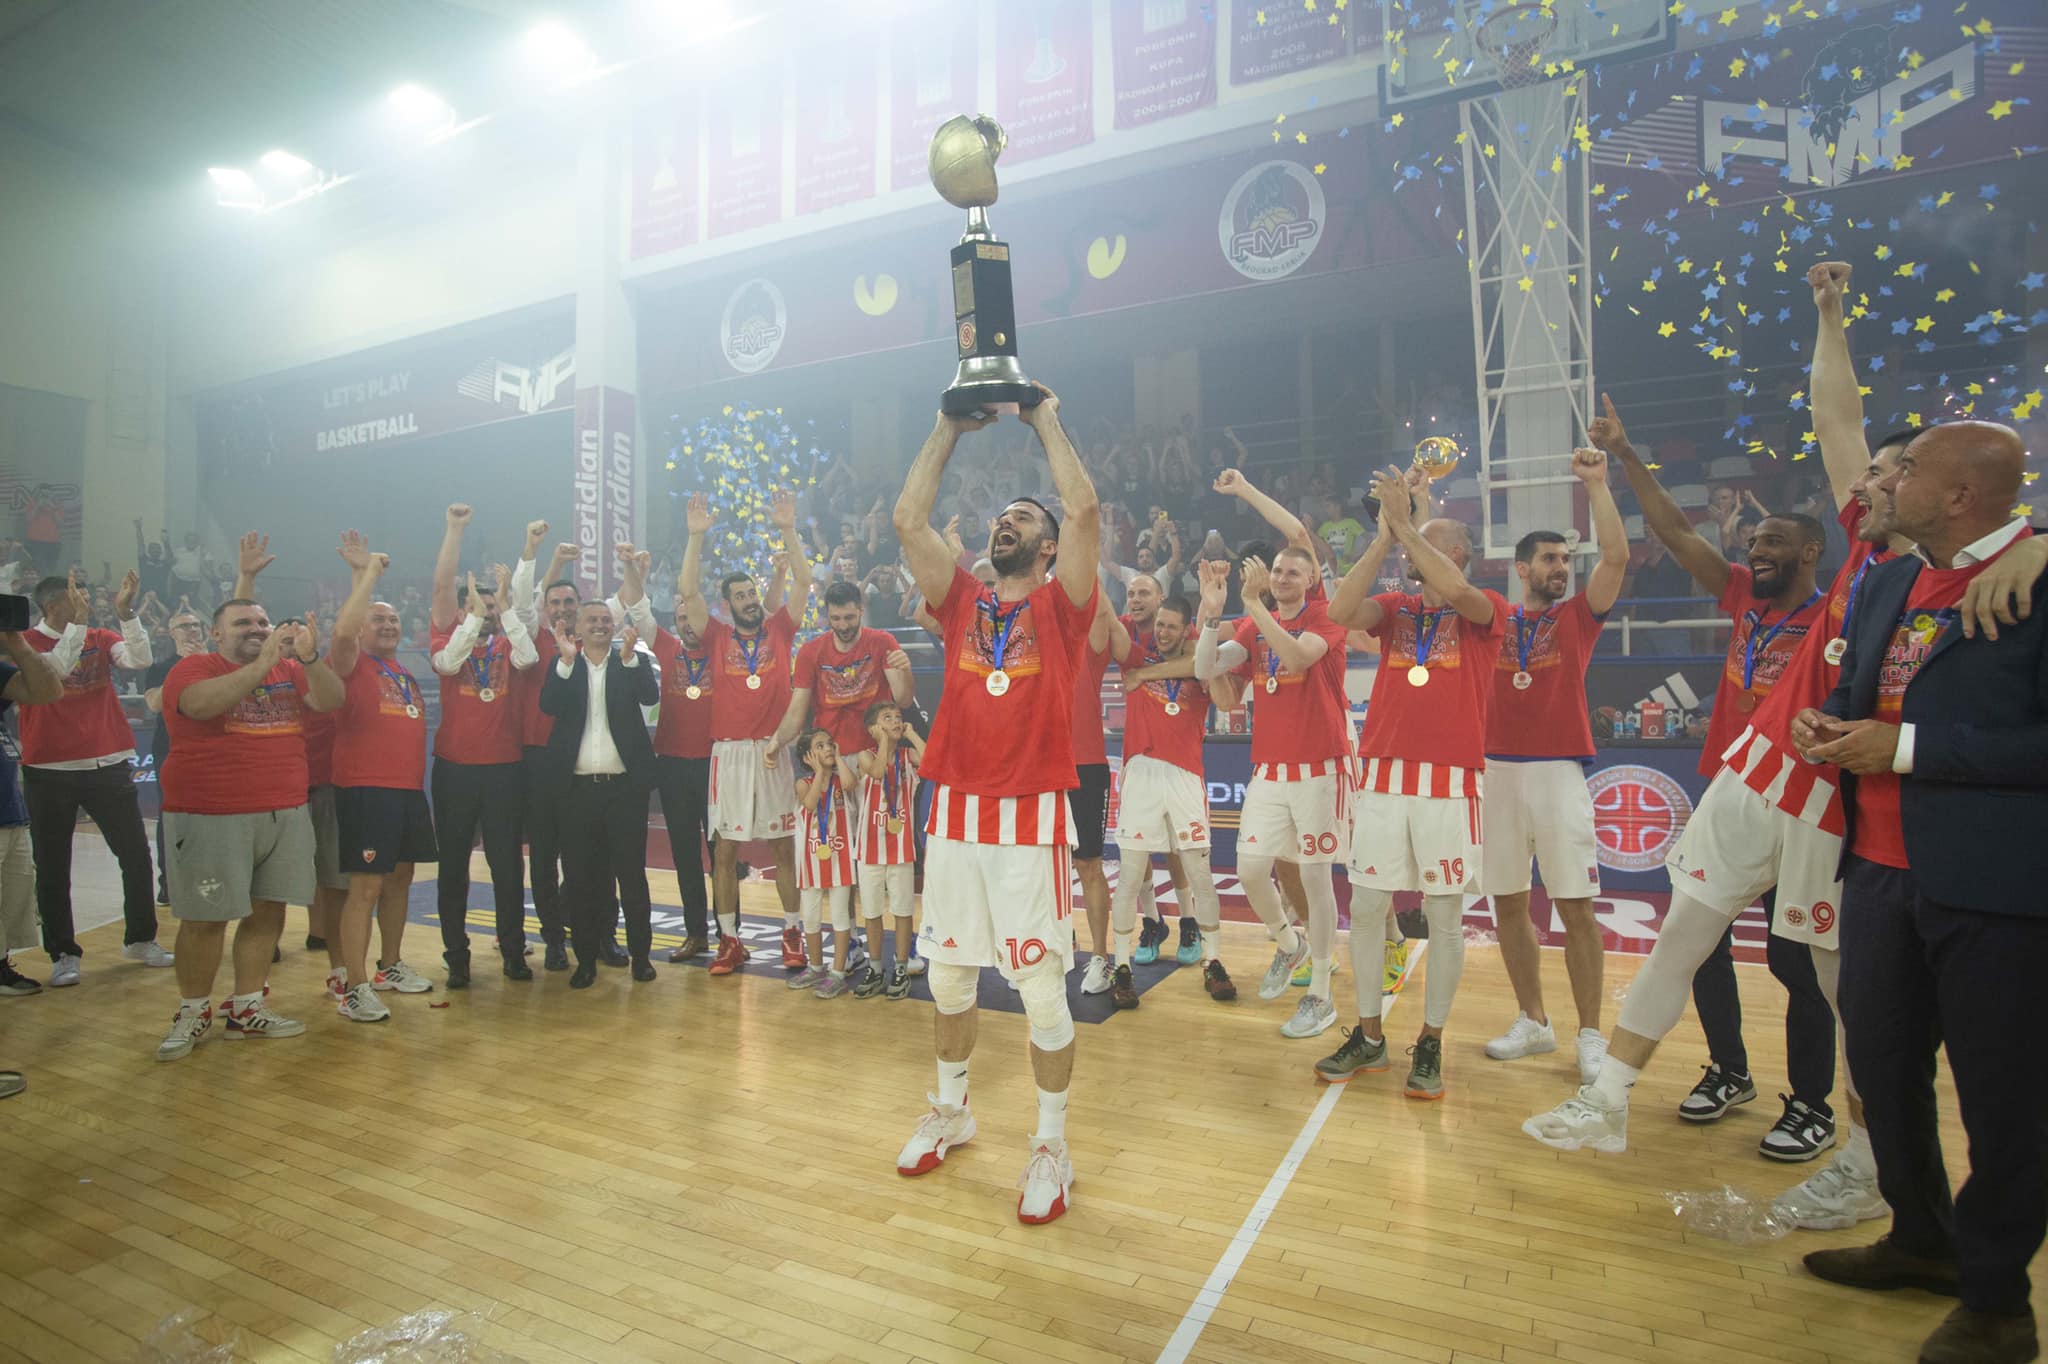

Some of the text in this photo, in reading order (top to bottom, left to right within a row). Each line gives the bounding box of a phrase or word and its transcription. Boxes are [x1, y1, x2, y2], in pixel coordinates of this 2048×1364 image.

[1700, 42, 1977, 188] FMP
[1231, 219, 1318, 259] FMP
[727, 325, 782, 356] FMP
[323, 370, 412, 409] LET'S PLAY
[493, 345, 576, 414] FMP
[315, 412, 420, 453] BASKETBALL
[575, 429, 598, 581] meridian
[780, 812, 796, 832] 12
[873, 808, 906, 826] ms
[1190, 821, 1206, 842] 2
[1303, 833, 1338, 857] 30
[1440, 857, 1465, 886] 19
[1811, 900, 1836, 935] 9
[1005, 937, 1048, 970] 10
